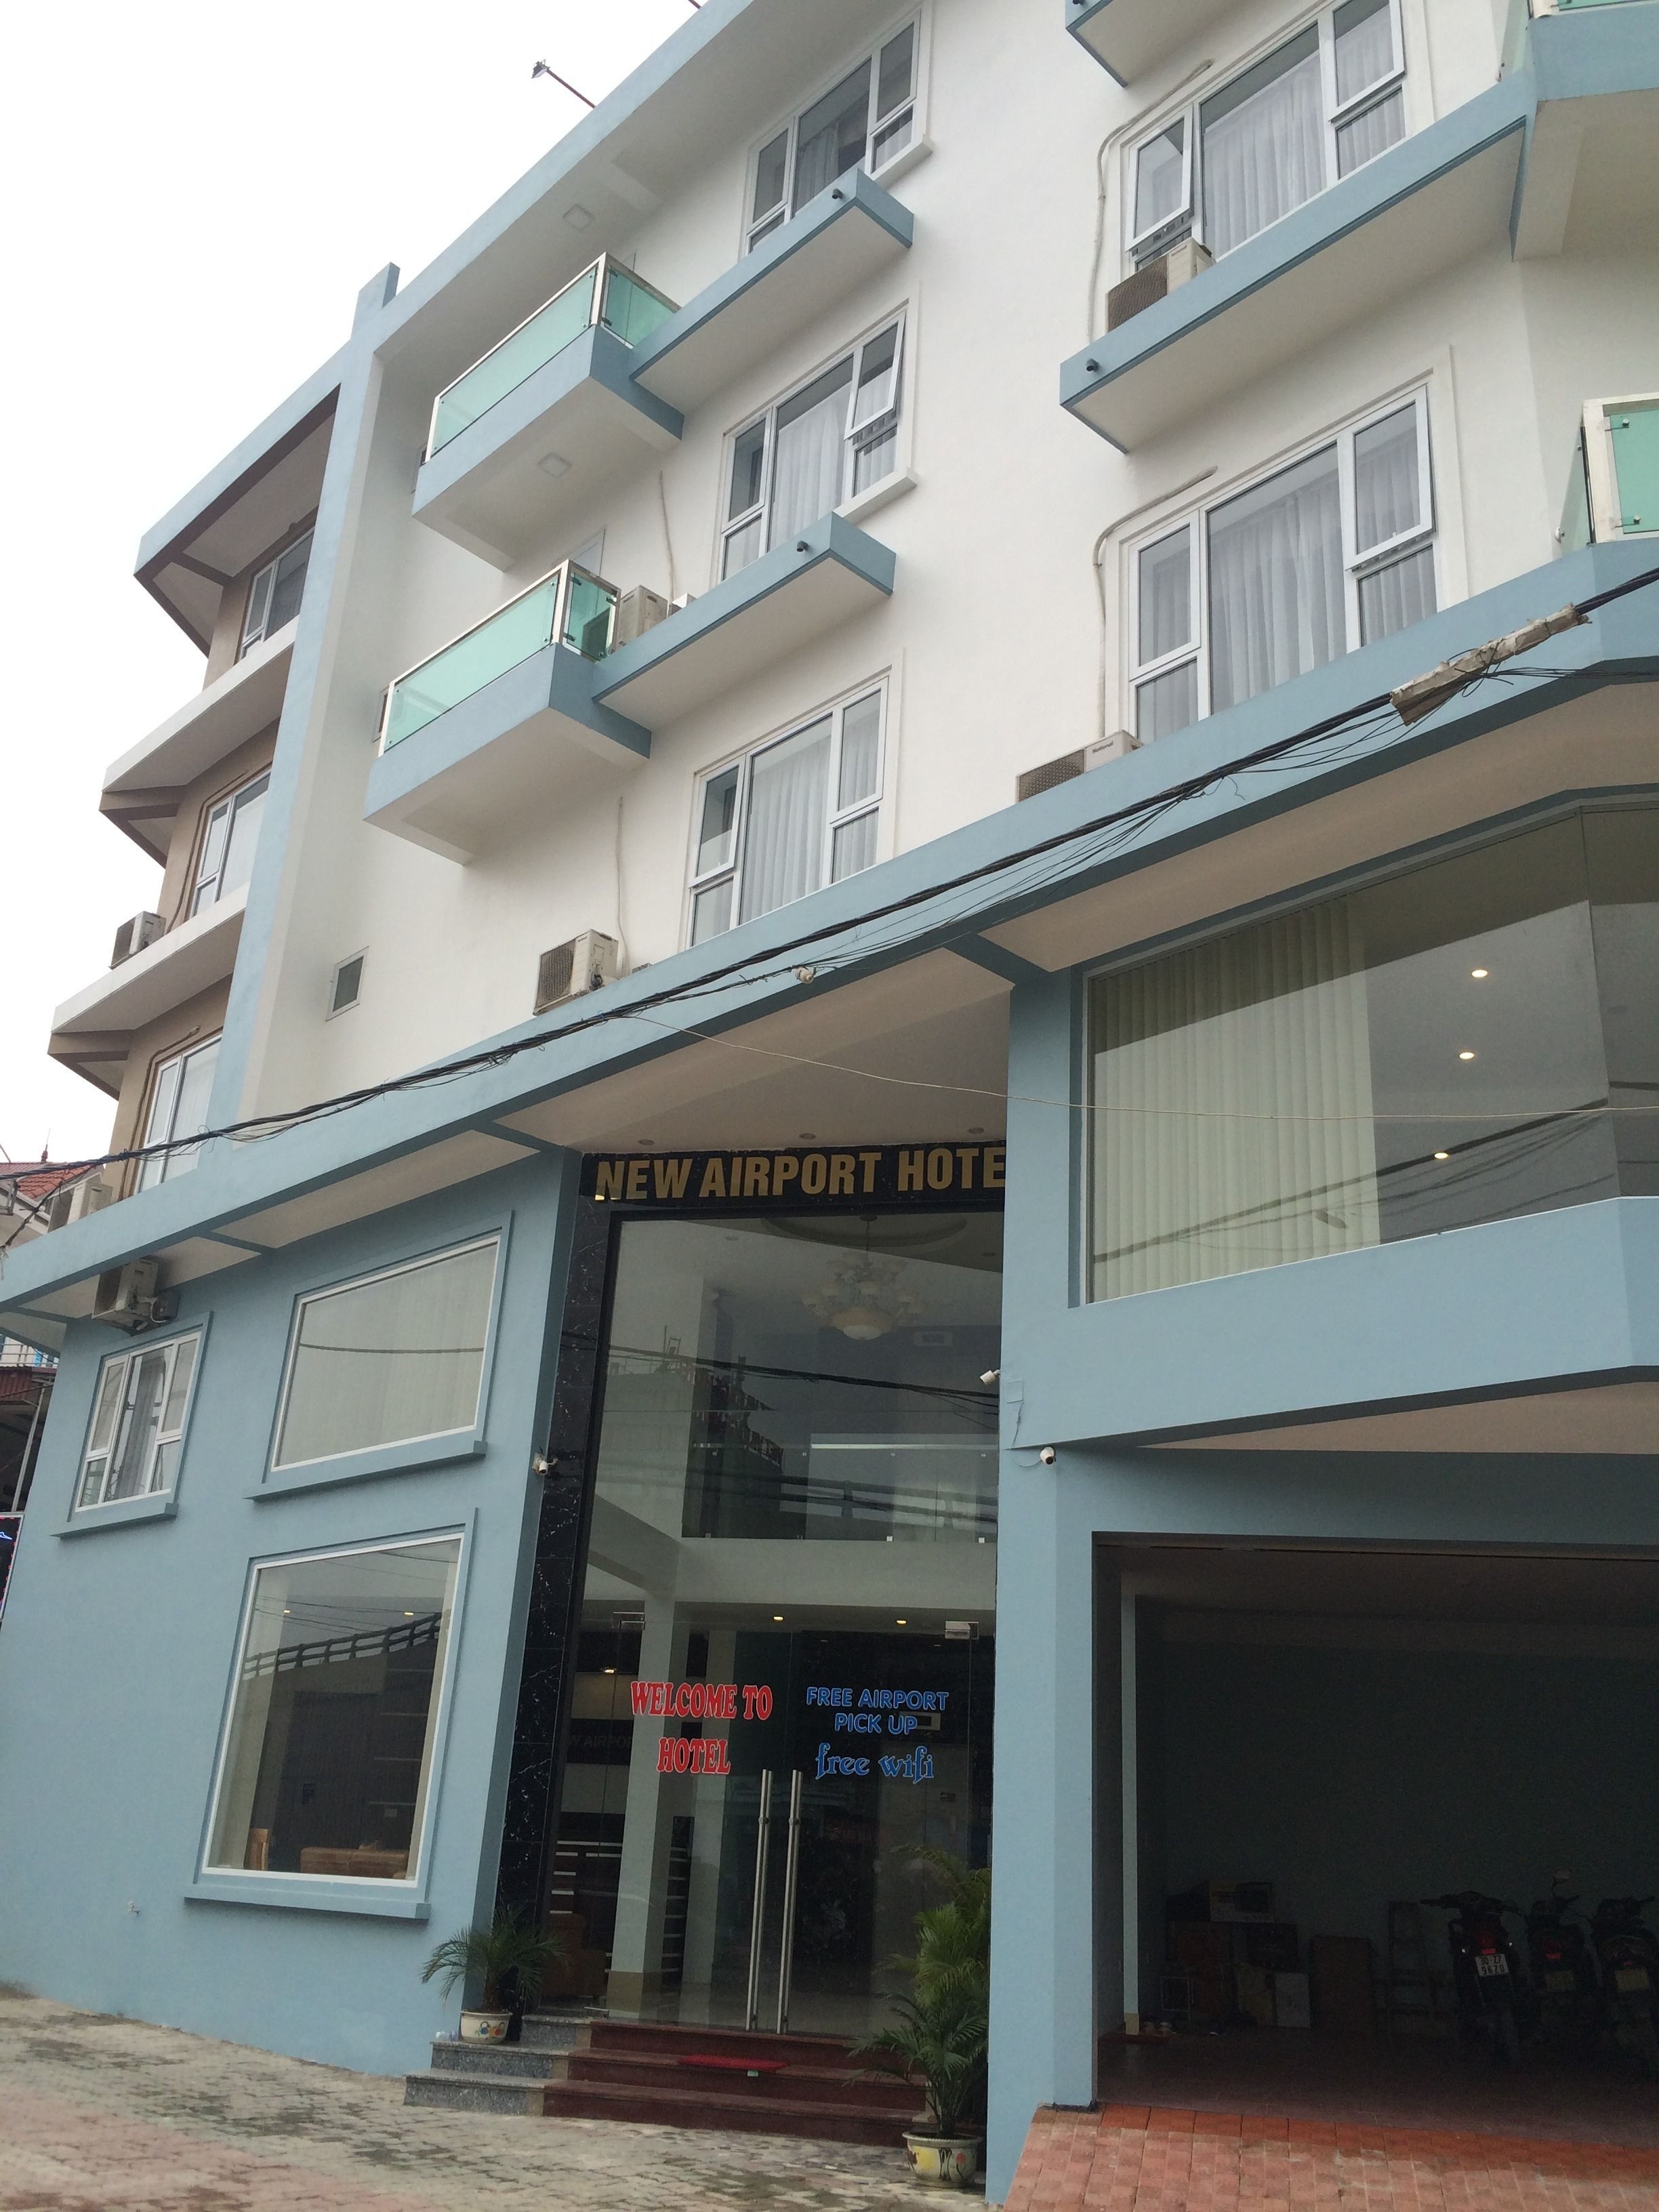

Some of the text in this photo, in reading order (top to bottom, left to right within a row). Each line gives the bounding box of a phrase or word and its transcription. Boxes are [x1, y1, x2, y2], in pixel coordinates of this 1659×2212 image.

[1092, 741, 1113, 754] National
[594, 1158, 693, 1202] NEW
[698, 1152, 882, 1198] AIRPORT
[630, 1681, 773, 1721] WELCOME TO
[806, 1687, 949, 1711] FREE AIRPORT
[834, 1714, 918, 1735] PICK UP
[656, 1737, 731, 1775] HOTEL
[815, 1742, 934, 1784] free wifi
